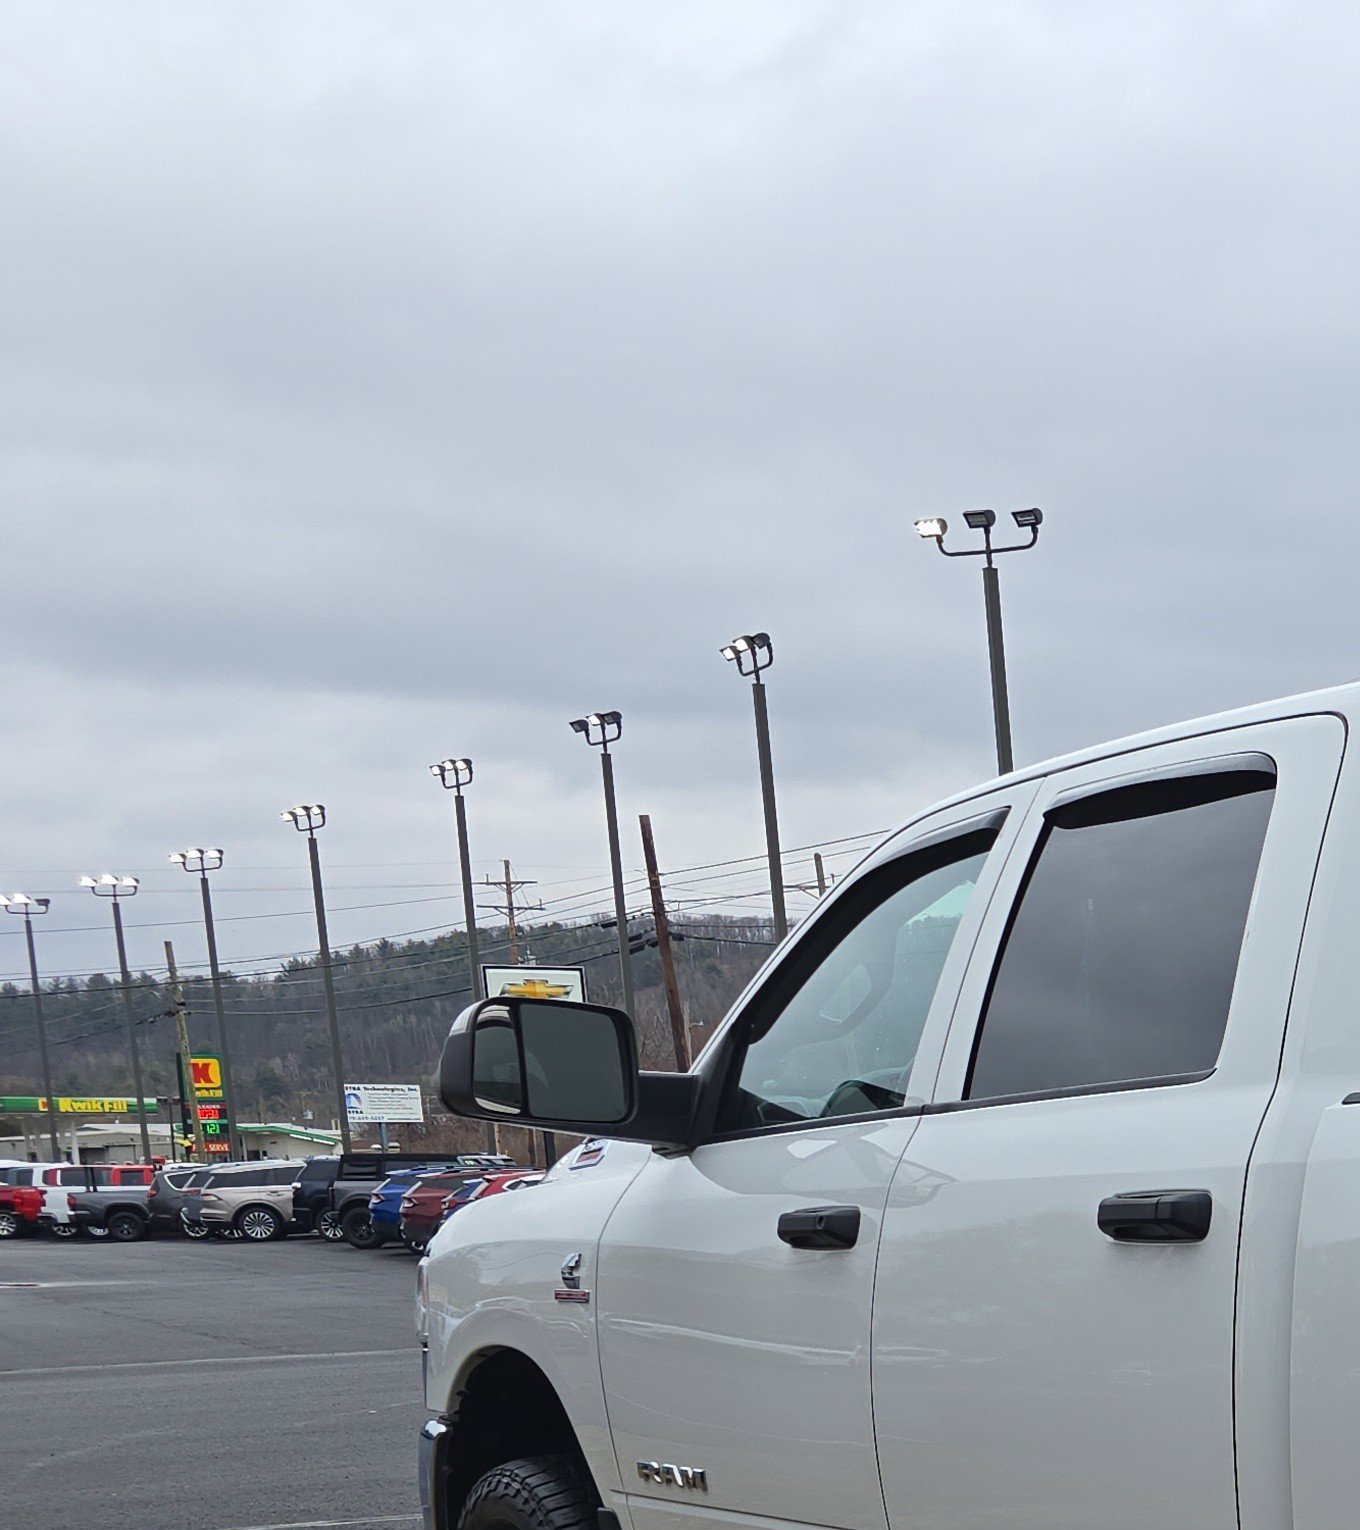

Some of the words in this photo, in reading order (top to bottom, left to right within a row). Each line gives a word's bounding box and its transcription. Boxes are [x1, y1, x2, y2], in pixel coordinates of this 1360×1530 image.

[191, 1063, 215, 1083] K
[58, 1099, 102, 1112] Kwik
[103, 1099, 128, 1112] Fill
[209, 1143, 230, 1152] SERVE
[636, 1461, 708, 1493] RAM
